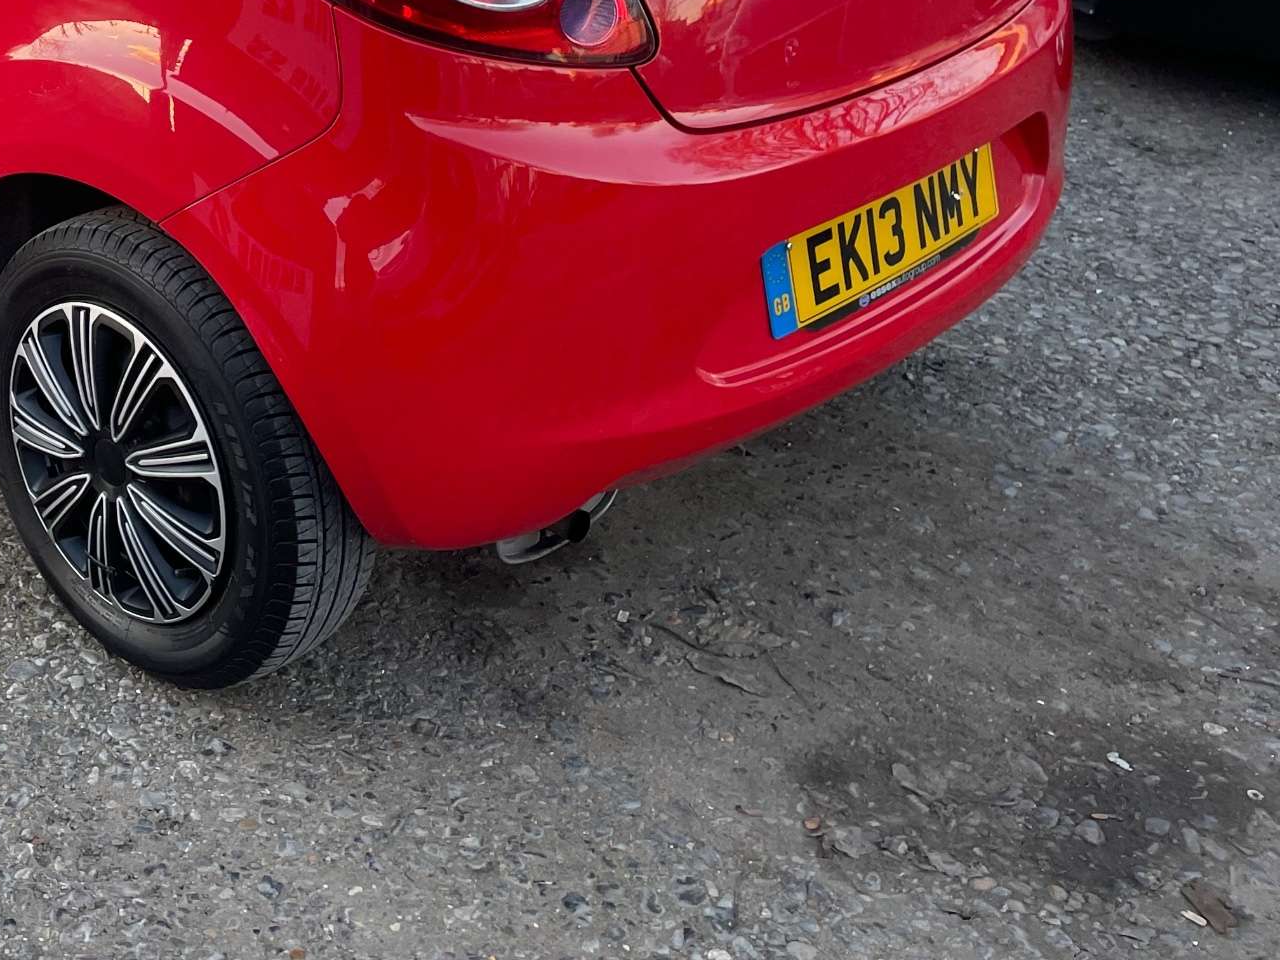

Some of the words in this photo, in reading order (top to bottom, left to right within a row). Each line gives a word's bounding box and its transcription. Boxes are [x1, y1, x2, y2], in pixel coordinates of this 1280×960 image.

[806, 196, 906, 306] EK13
[913, 150, 979, 250] NMY
[773, 293, 791, 317] GB
